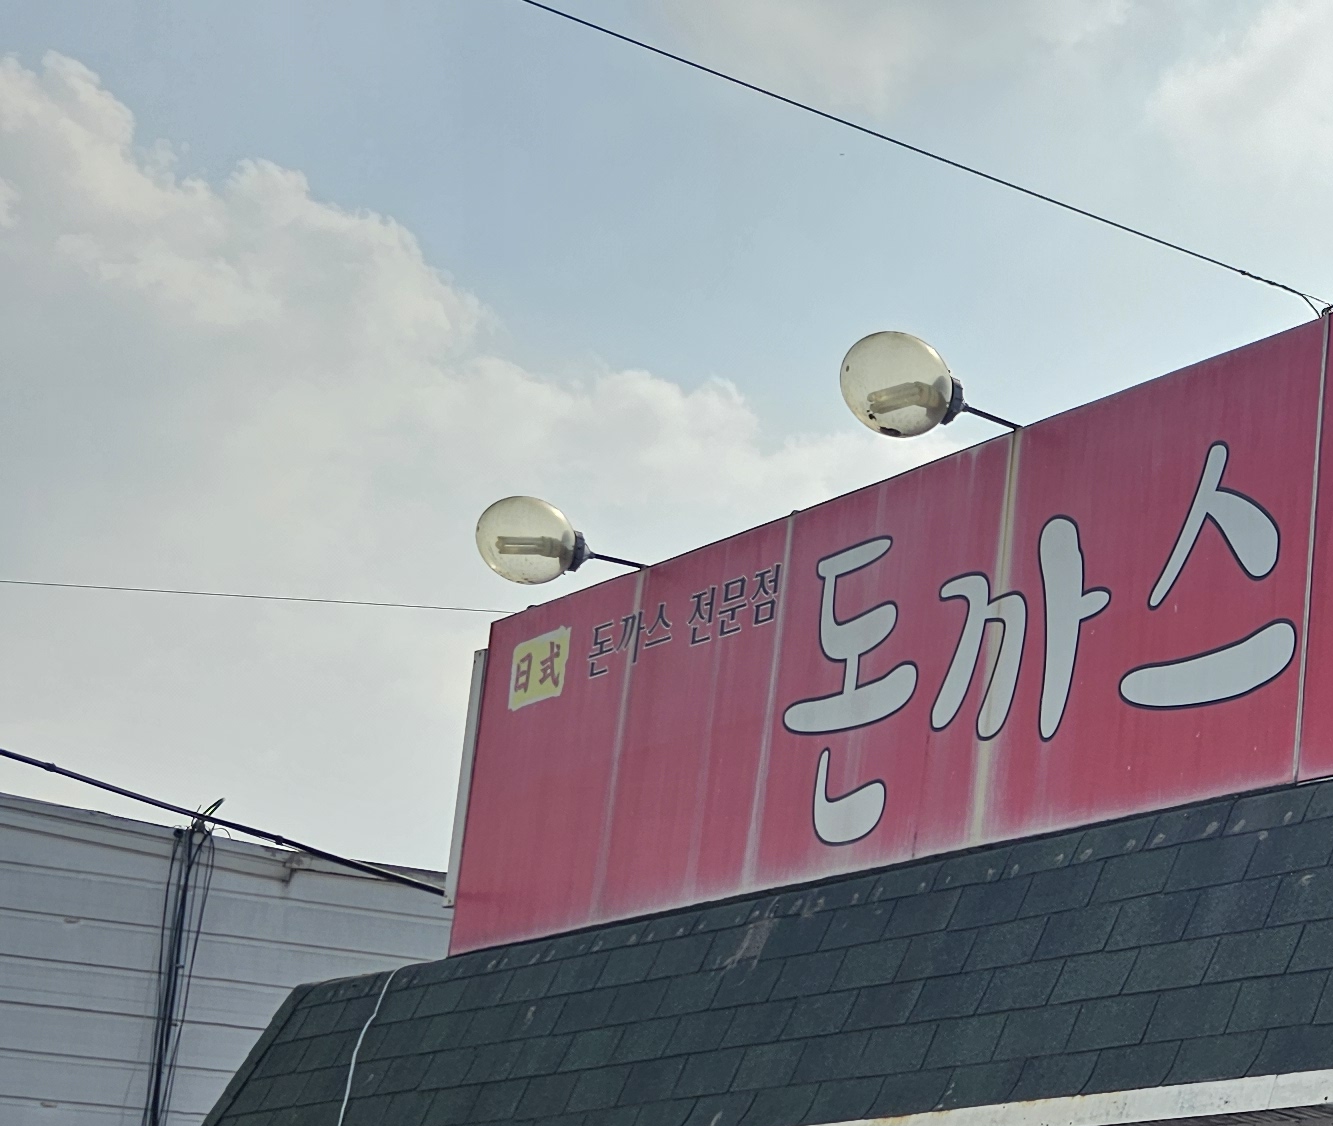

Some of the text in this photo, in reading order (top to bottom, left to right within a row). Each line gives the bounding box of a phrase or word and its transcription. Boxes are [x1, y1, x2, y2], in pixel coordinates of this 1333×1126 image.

[513, 641, 561, 694] 日式
[587, 563, 782, 680] 돈까스 전문점
[783, 440, 1297, 846] 돈까스
